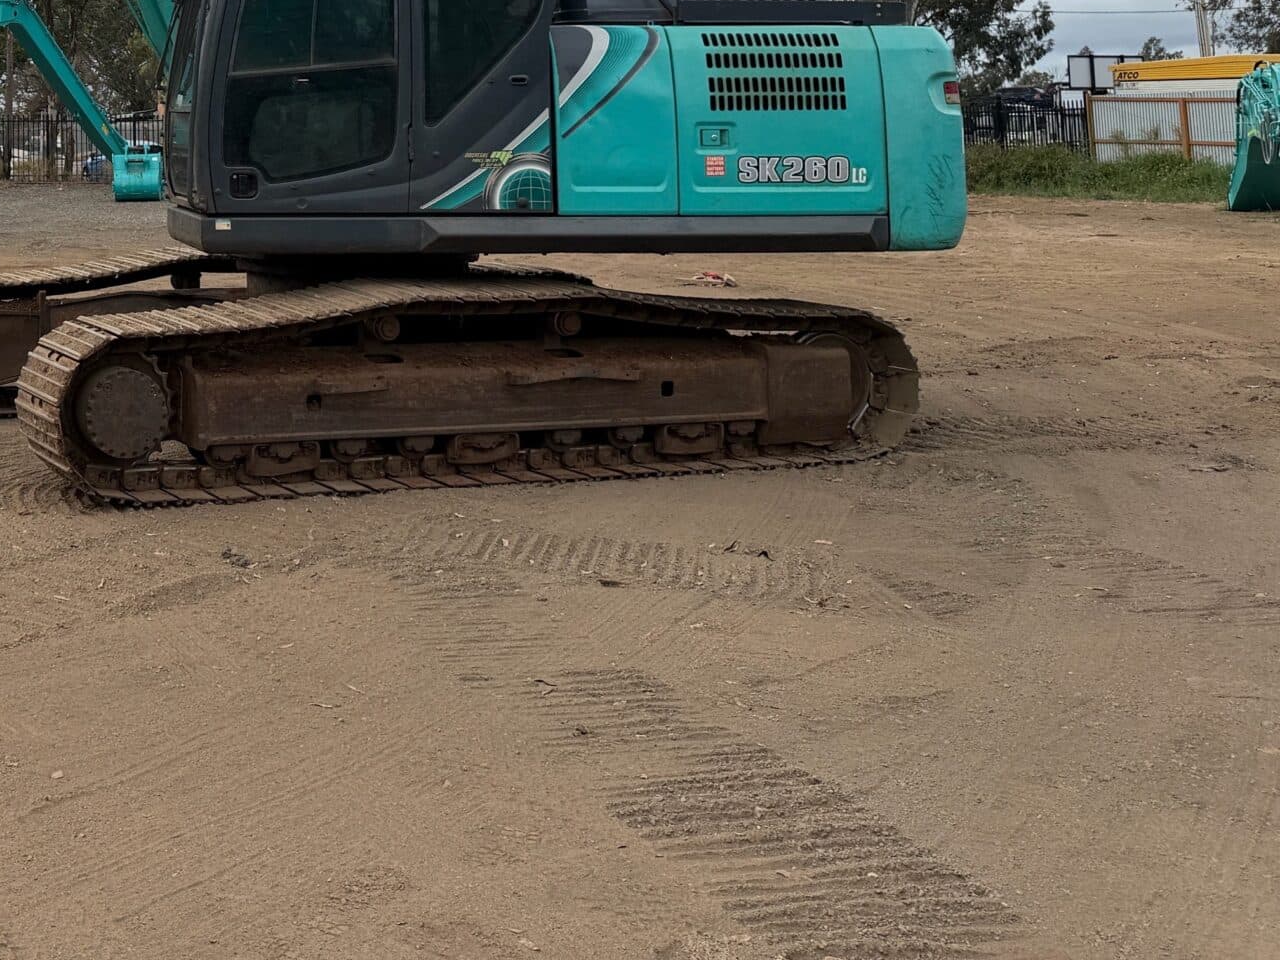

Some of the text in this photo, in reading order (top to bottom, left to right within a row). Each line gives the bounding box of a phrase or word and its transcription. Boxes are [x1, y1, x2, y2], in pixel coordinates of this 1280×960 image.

[1117, 71, 1139, 80] ATCO
[738, 156, 867, 183] SK260 LC
